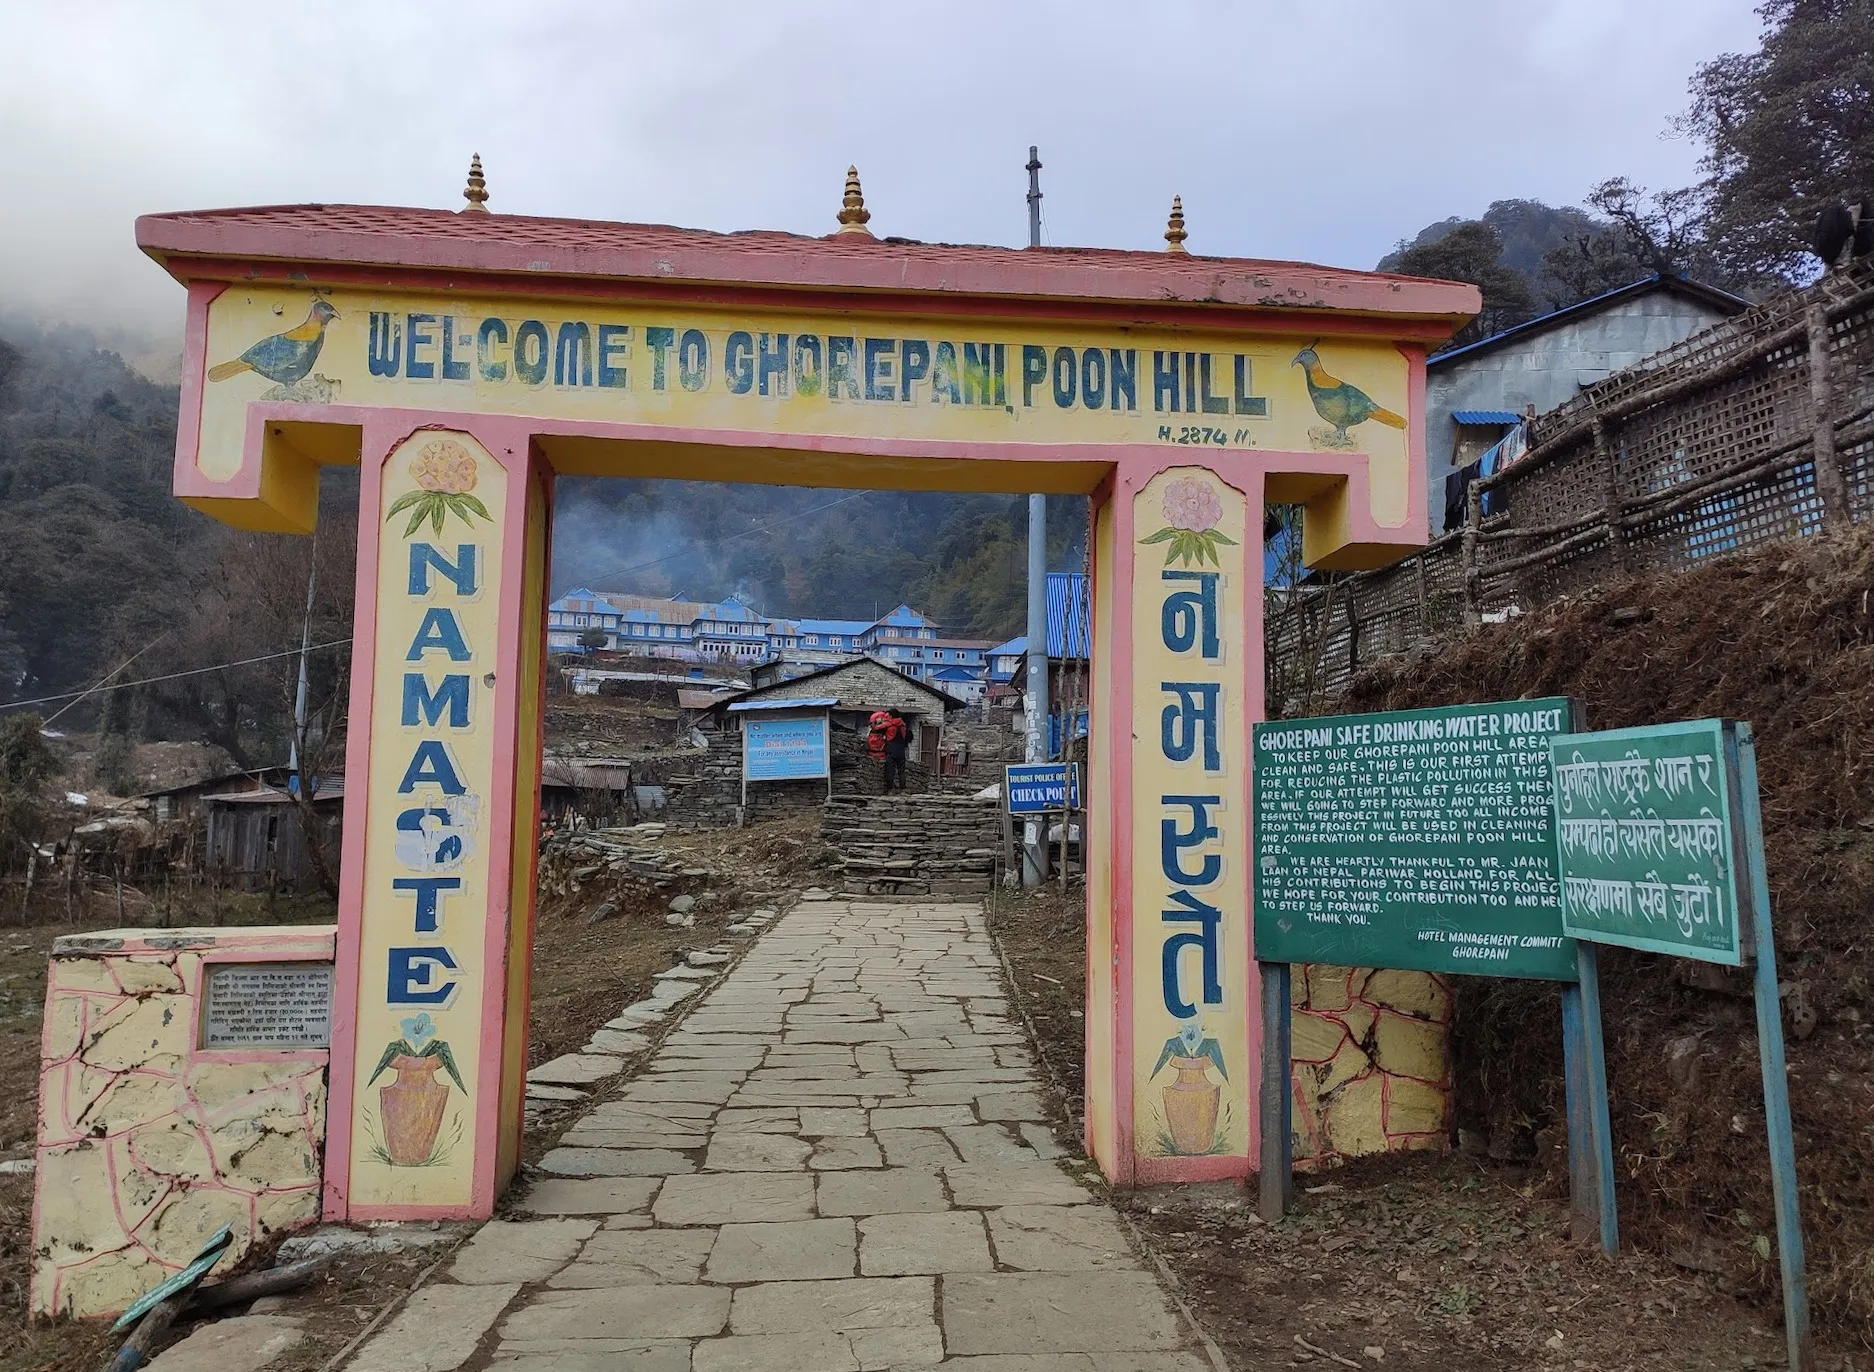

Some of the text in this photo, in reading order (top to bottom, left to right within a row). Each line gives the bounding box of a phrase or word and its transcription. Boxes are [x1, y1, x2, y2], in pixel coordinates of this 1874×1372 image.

[646, 327, 708, 393] TO
[1022, 345, 1138, 412] POON
[1154, 351, 1267, 416] HILL
[1260, 709, 1561, 750] GHOREPANI SAFE DRINKING WATER PROJECT
[1272, 752, 1286, 763] TO
[1288, 750, 1320, 763] KEEP
[1326, 748, 1350, 760] OUR
[1354, 743, 1429, 759] GHOREPANI
[1434, 741, 1469, 754] POON
[1473, 739, 1503, 752] HILL
[1262, 766, 1297, 776] CLEAN
[1302, 764, 1323, 775] AND
[1328, 762, 1365, 773] SAFE,
[1368, 760, 1397, 771] THIS
[1403, 758, 1415, 770] IS
[1420, 756, 1449, 769] OUR
[1452, 754, 1490, 768] FIRST
[1010, 772, 1075, 783] TOURIST POLICE OFFE
[1261, 766, 1548, 789] FOR REDUCING THE PLASTIC POLLUTION IN THIS
[1654, 757, 1694, 801] शान
[1697, 755, 1717, 796] र
[1011, 788, 1045, 802] CHECK
[1295, 790, 1305, 799] IF
[1310, 789, 1334, 799] OUR
[1338, 786, 1386, 798] ATTEMPT
[1391, 785, 1417, 797] WILL
[1422, 784, 1449, 796] GET
[1454, 782, 1512, 795] SUCCESS
[1261, 802, 1276, 810] WE
[1280, 802, 1302, 811] WILL
[1307, 801, 1338, 811] GOING
[1342, 800, 1355, 809] TO
[1360, 800, 1387, 809] STEP
[1392, 798, 1446, 808] FORWARD
[1451, 797, 1475, 807] AND
[1480, 796, 1513, 806] MORE
[1262, 806, 1548, 821] ESSIVELY THIS PROJECT IN FUTURE TOO ALL INCOME
[1261, 820, 1548, 833] FROM THIS PROJECT WILL BE USED IN CLEANING
[1261, 832, 1546, 844] AND CONSERVATION OF GHOREPANI POON HILL
[1666, 807, 1724, 863] यसको
[1261, 845, 1291, 854] AREA.
[1290, 856, 1549, 868] WE ARE HEARTLY THANKFUL TO MR. JAAN
[1262, 867, 1555, 881] LAAN OF NEPAL PARIWAR HOLLAND FOR ALL
[1262, 878, 1561, 893] HIS CONTRIBUTIONS TO BEGIN THIS PROJEC
[1262, 889, 1279, 898] WE
[1284, 890, 1315, 899] HOPE
[1322, 890, 1348, 901] FOR
[1350, 891, 1381, 902] YOUR
[1386, 892, 1477, 904] CONTRIBUTION
[1481, 894, 1507, 906] TOO
[1515, 896, 1538, 907] AND
[1262, 901, 1383, 913] TO STEP US FORWARD.
[1307, 912, 1371, 925] THANK YOU.
[1418, 931, 1445, 942] HOTEL
[1448, 932, 1519, 946] MANAGEMENT
[1452, 947, 1509, 960] GHOREPANI
